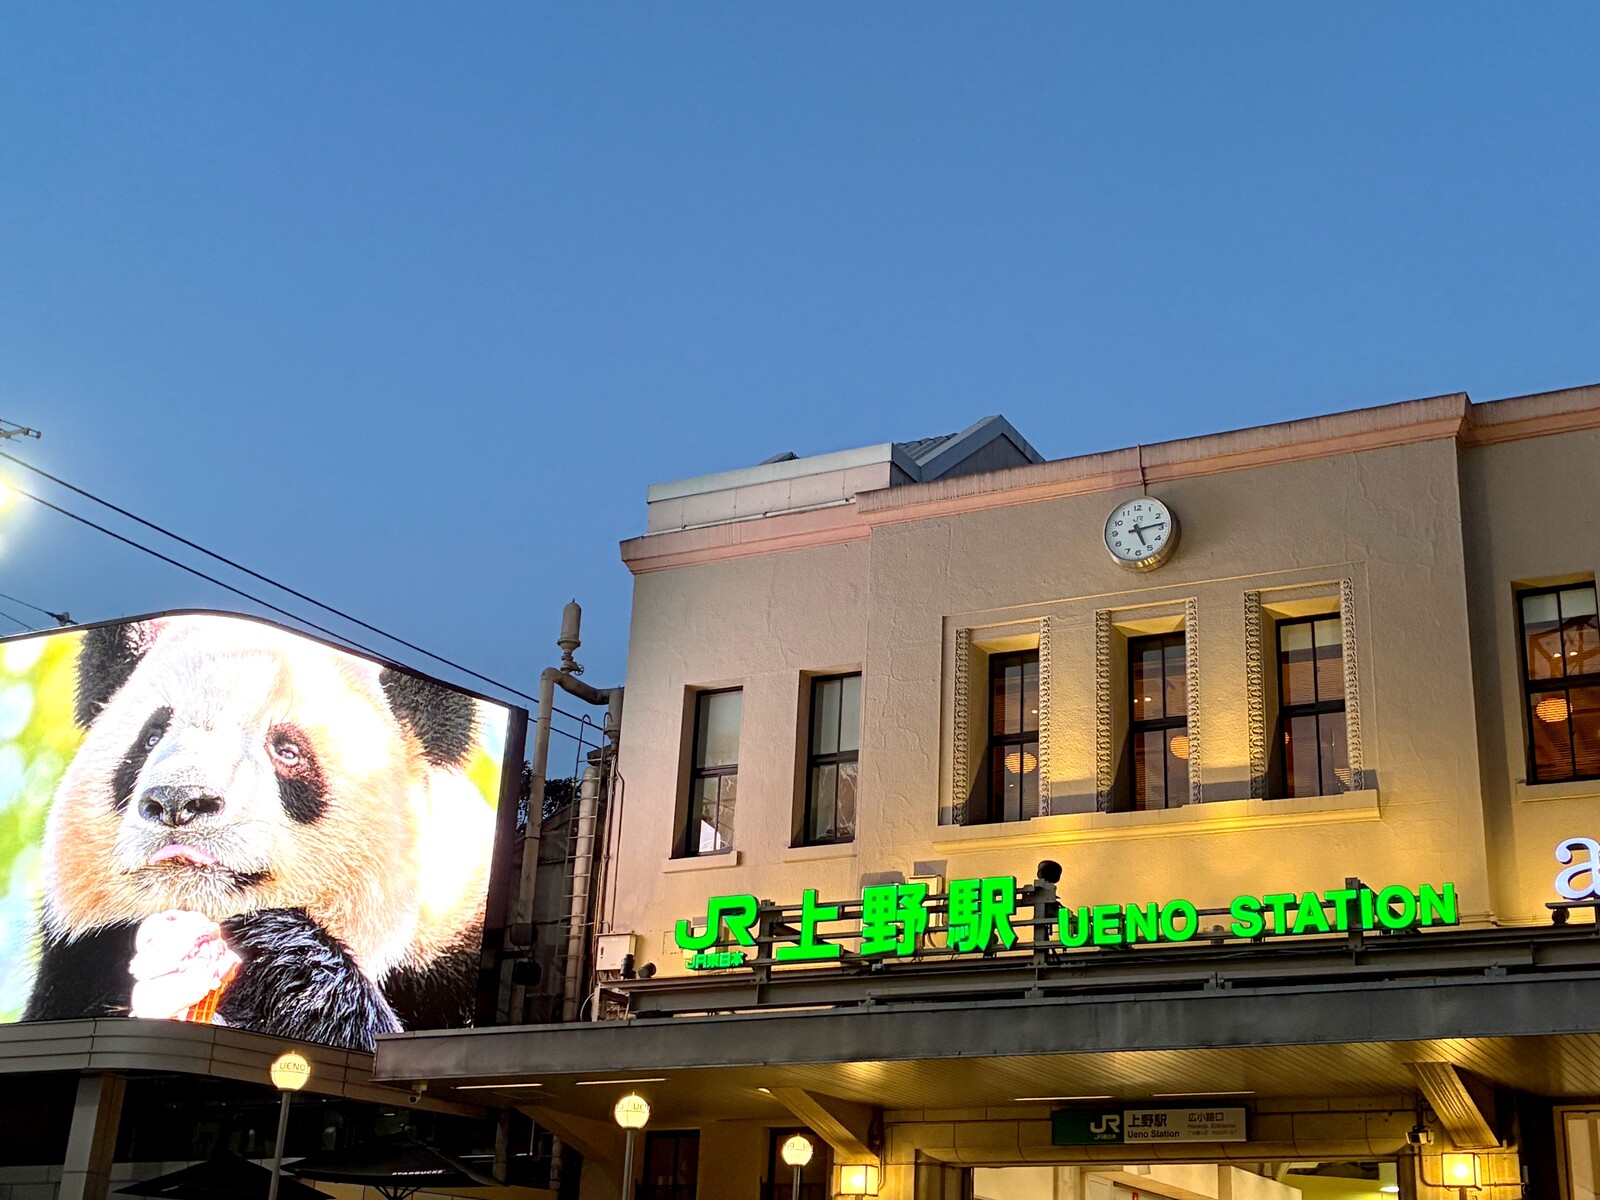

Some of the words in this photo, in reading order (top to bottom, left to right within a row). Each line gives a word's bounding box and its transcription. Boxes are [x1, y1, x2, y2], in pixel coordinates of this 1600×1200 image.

[1155, 512, 1161, 520] 2
[1135, 549, 1142, 557] 6
[1146, 544, 1154, 552] 5
[674, 893, 758, 951] JR
[775, 875, 1018, 962] 上野駅
[1057, 898, 1199, 948] UENO
[1230, 882, 1458, 939] STATION
[685, 951, 744, 969] JR東日本
[280, 1062, 306, 1072] UENO
[1090, 1114, 1120, 1133] JR
[1127, 1113, 1168, 1128] 上野駅
[1127, 1130, 1149, 1139] Ueno
[1150, 1129, 1180, 1138] Station
